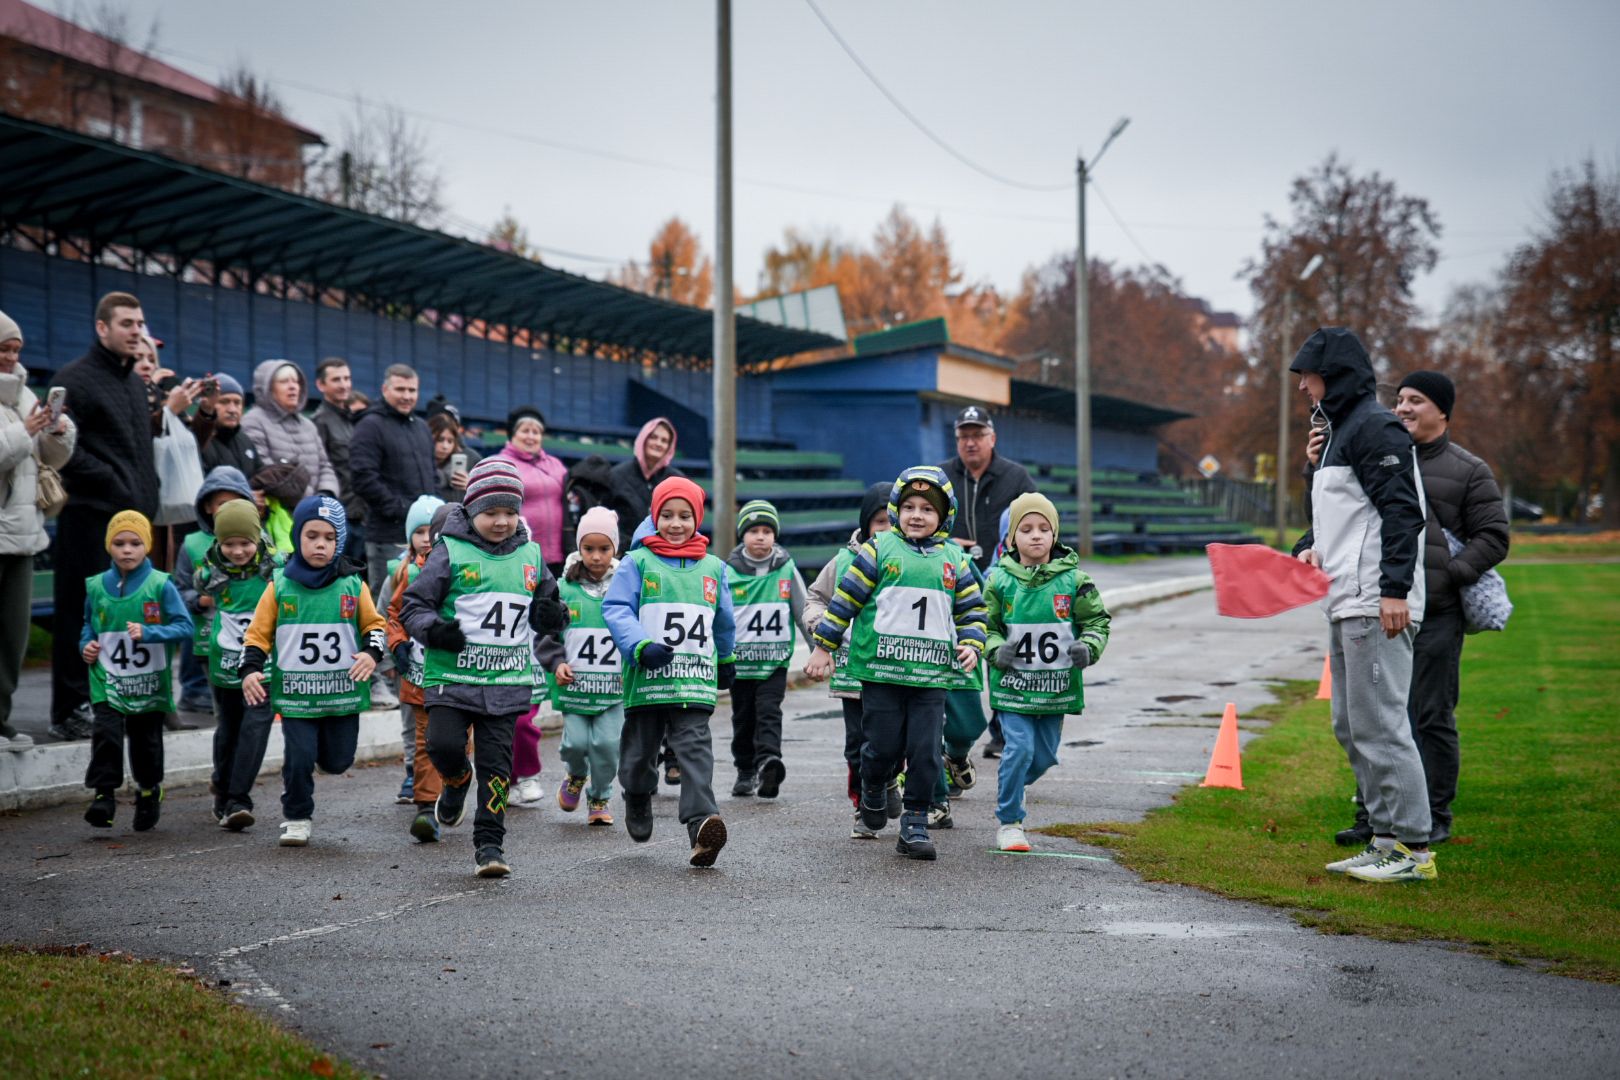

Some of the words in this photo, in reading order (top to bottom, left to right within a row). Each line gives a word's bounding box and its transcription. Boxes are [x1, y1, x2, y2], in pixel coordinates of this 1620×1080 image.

[480, 601, 527, 639] 47
[747, 609, 784, 636] 44
[911, 596, 928, 631] 1
[663, 612, 708, 648] 54
[878, 635, 933, 649] СПОРТИВНЫЙ
[110, 638, 151, 670] 45
[298, 632, 341, 665] 53
[577, 635, 617, 666] 42
[876, 644, 951, 665] БРОННИЦЫ
[1015, 631, 1060, 664] 46
[282, 671, 334, 681] СПОРТИВНЫЙ
[335, 671, 350, 680] КЛУ
[282, 679, 355, 695] БРОННИЦЫ
